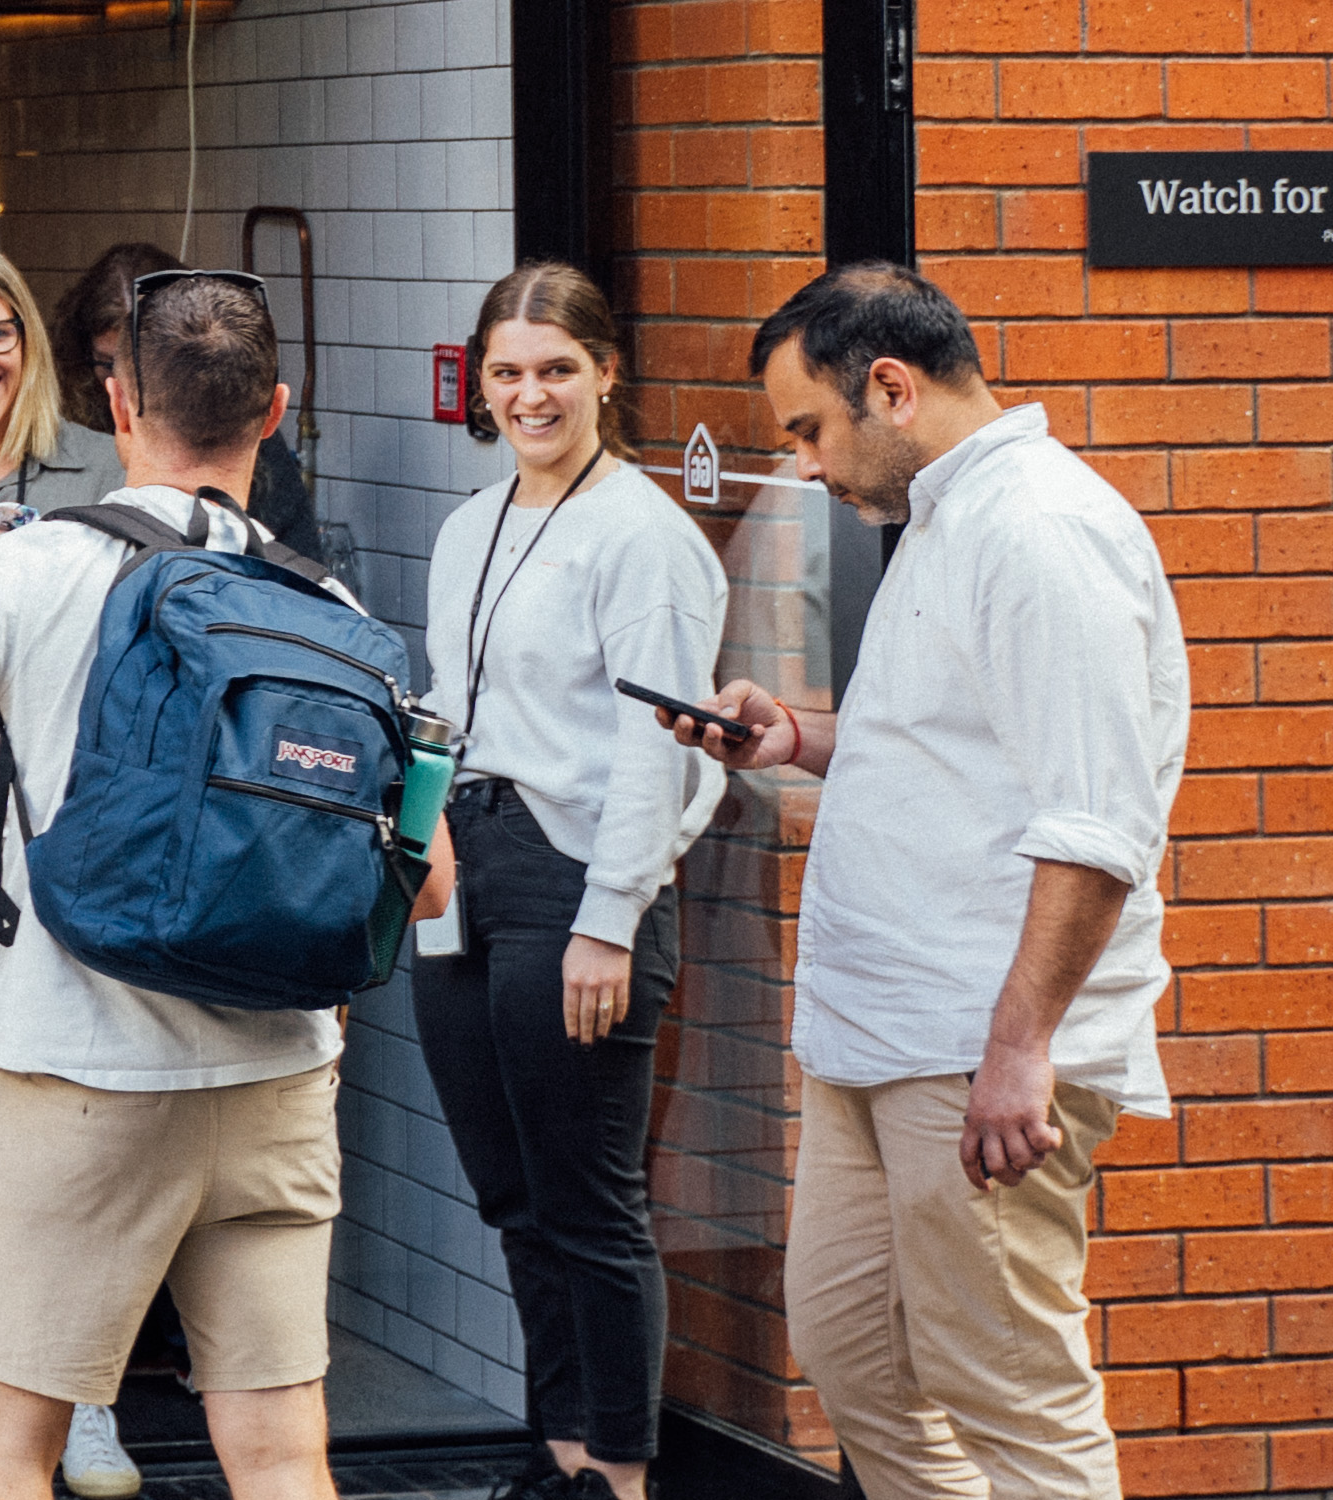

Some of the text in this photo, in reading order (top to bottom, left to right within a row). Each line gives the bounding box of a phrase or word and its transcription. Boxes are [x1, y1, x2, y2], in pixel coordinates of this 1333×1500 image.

[1137, 177, 1329, 215] Watch for
[275, 740, 357, 774] JANSPORT
